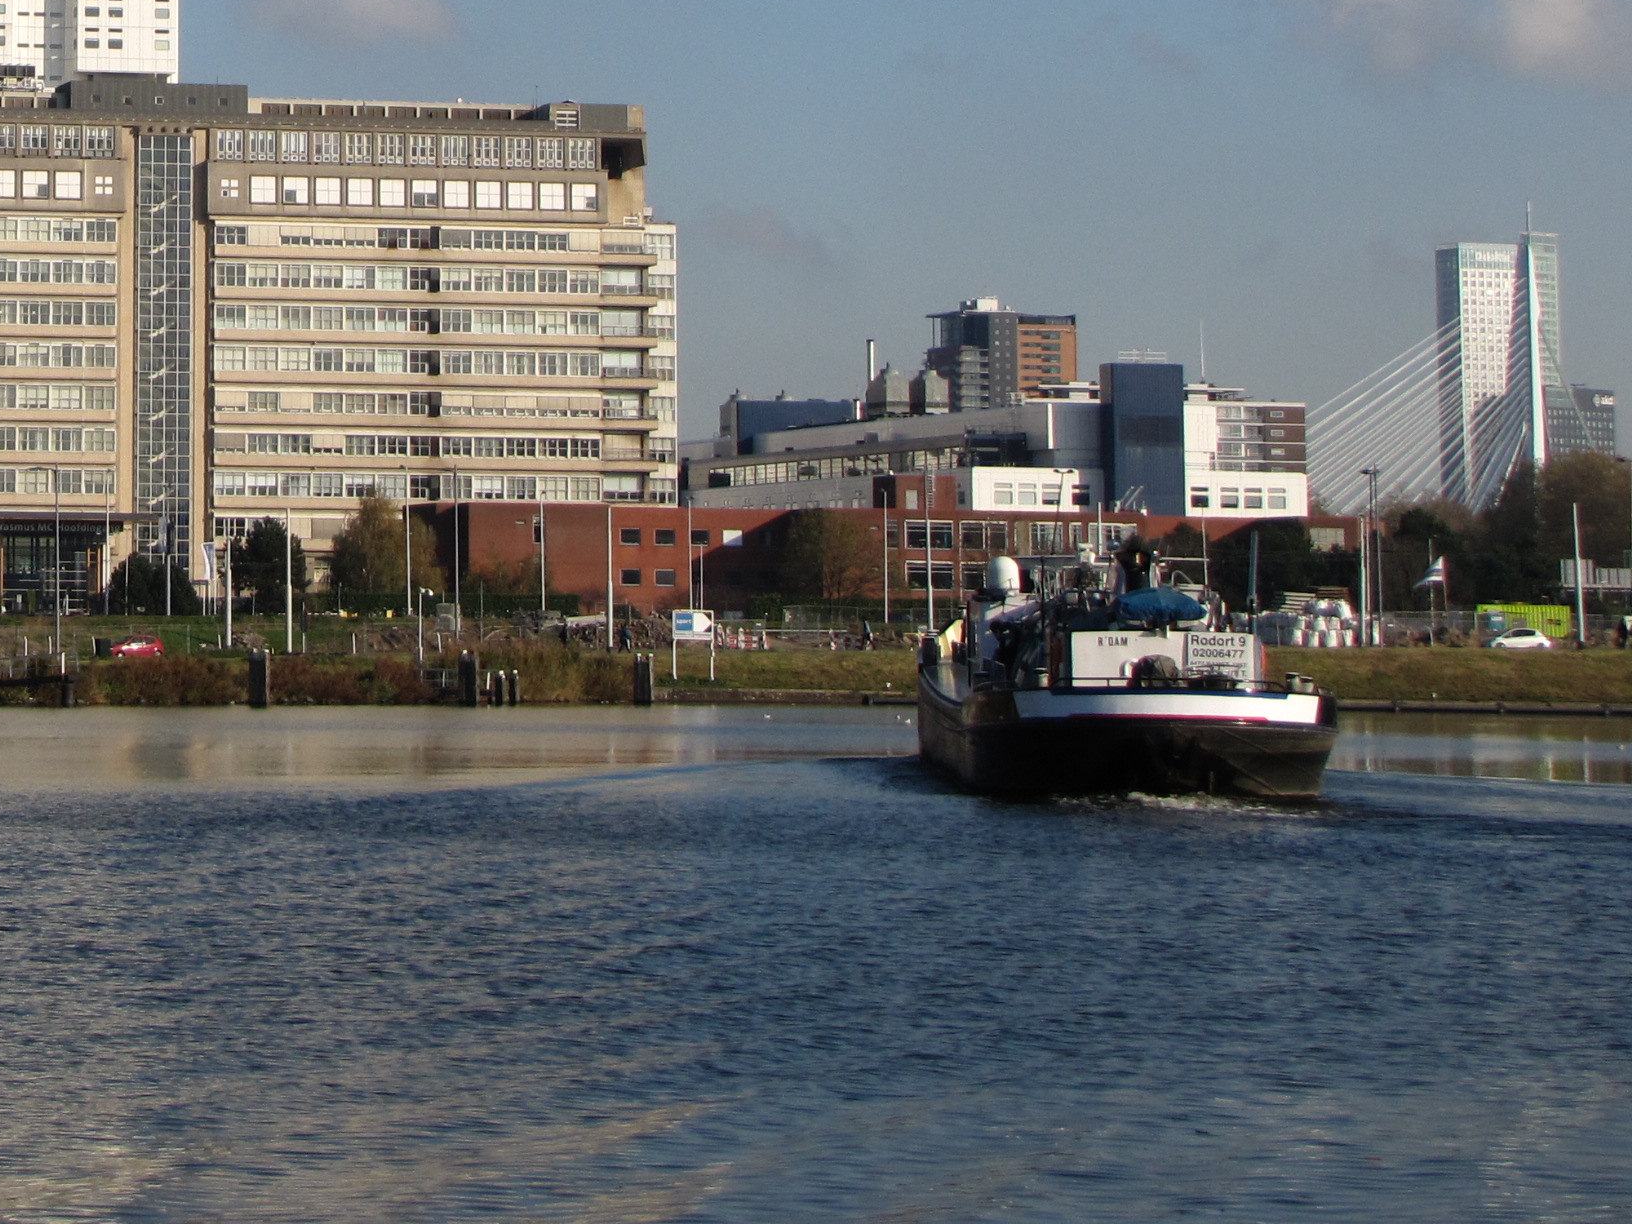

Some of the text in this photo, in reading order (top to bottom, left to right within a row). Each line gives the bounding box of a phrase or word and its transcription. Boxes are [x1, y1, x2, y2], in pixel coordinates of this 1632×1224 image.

[37, 523, 53, 532] MC
[1191, 634, 1246, 647] Rodort 9
[1192, 648, 1244, 658] 02006477
